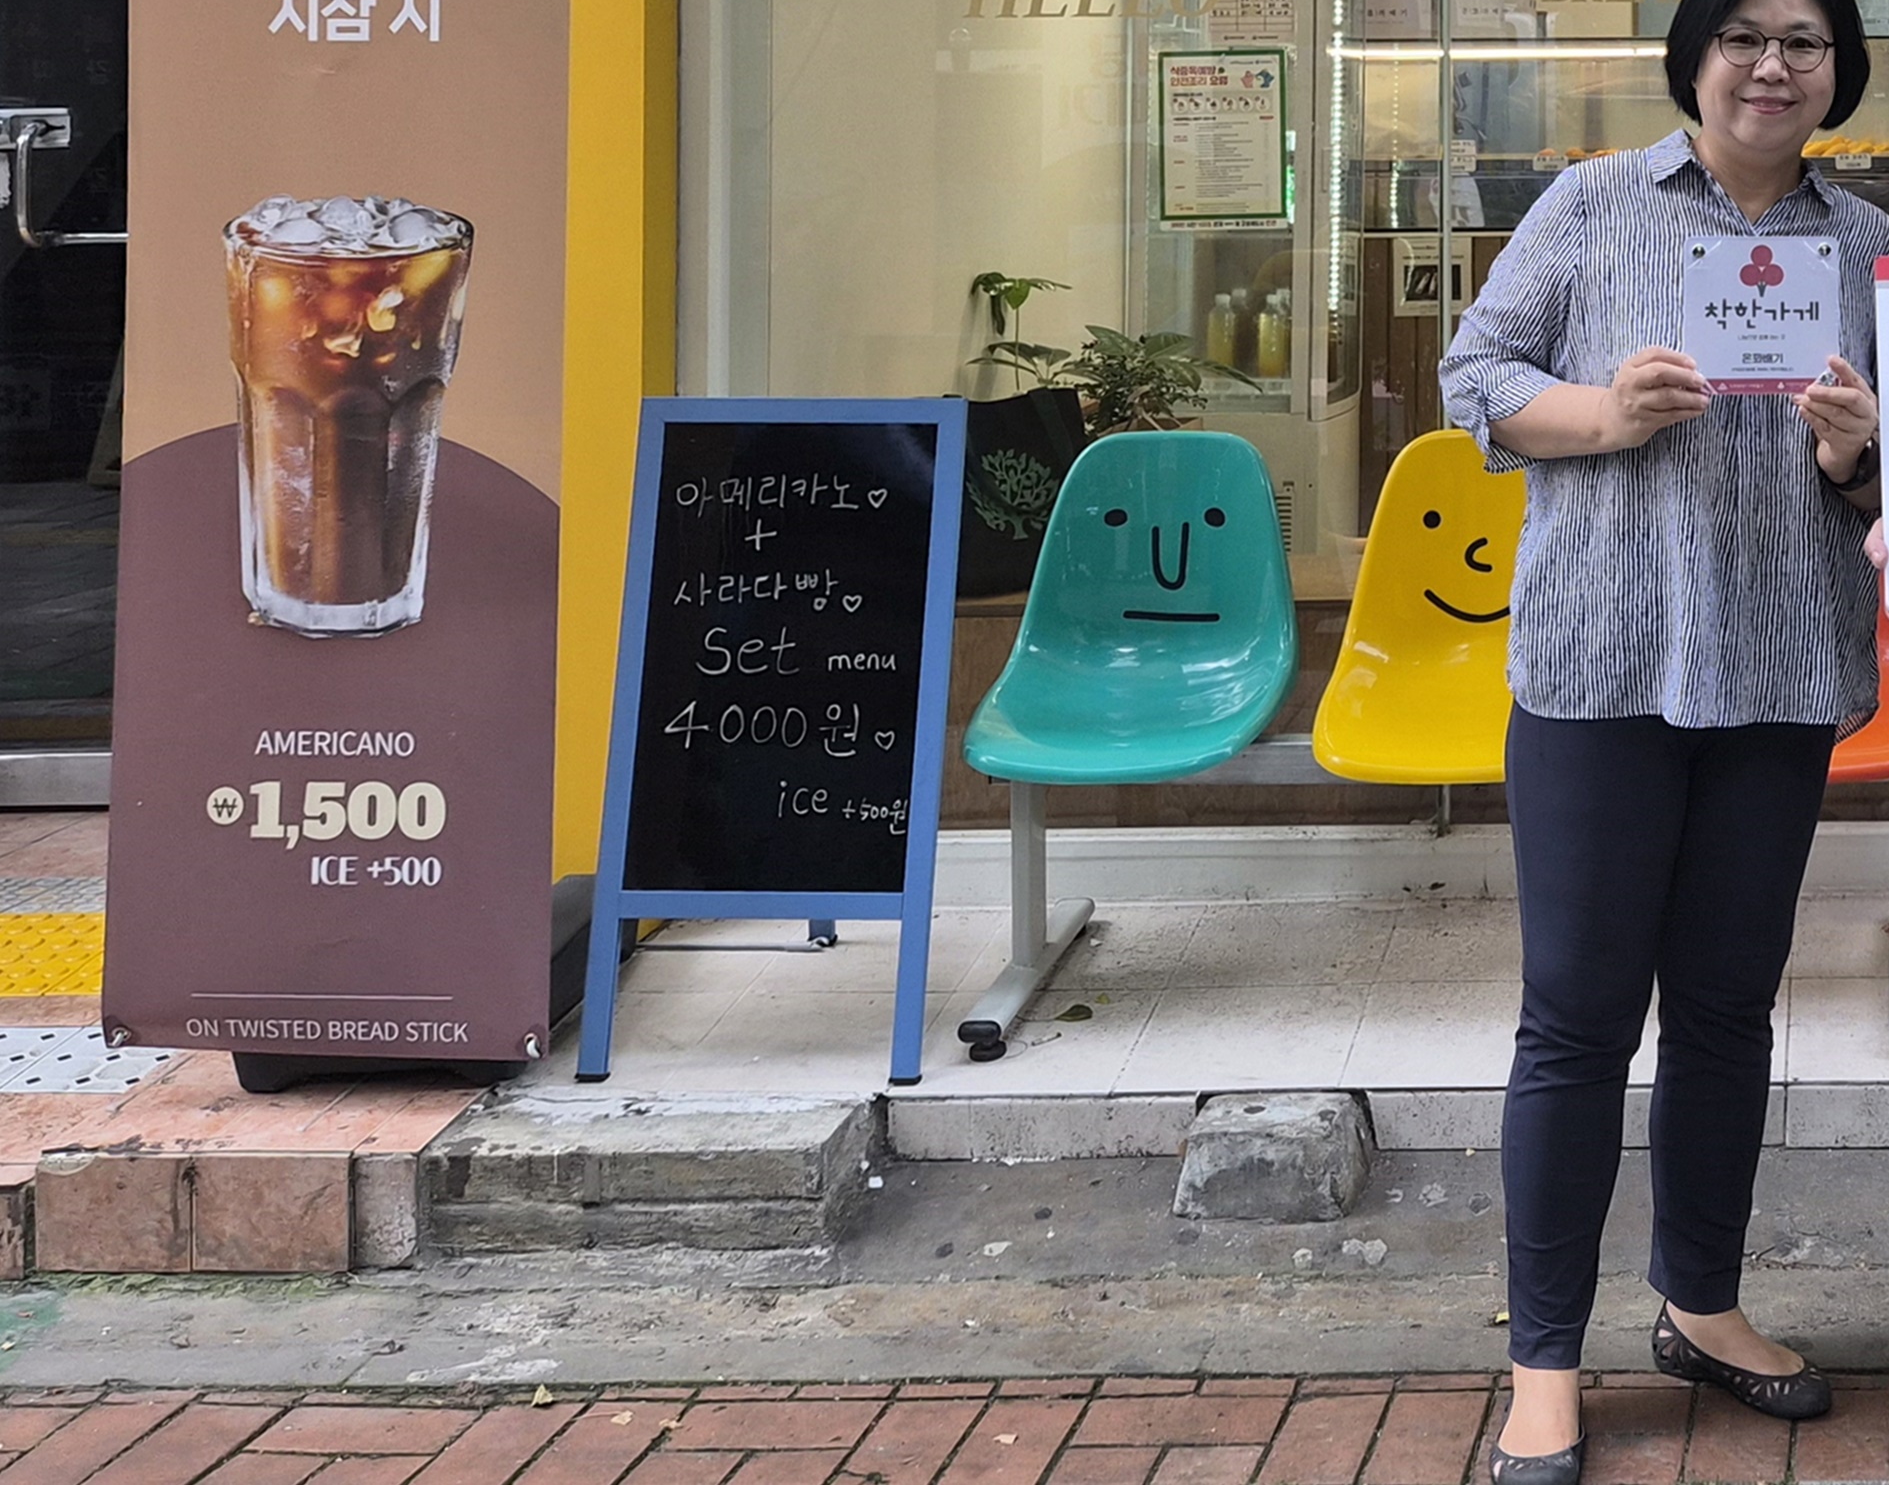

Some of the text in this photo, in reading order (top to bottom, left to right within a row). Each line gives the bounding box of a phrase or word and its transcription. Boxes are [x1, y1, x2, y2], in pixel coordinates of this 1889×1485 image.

[1704, 298, 1820, 330] 착한가게
[675, 472, 861, 518] 아메리카노
[673, 568, 839, 612] 사라다빵
[695, 625, 897, 676] Set menu
[254, 730, 416, 757] AMERICANO
[777, 780, 829, 818] ice
[310, 856, 443, 887] ICE +500
[186, 1018, 469, 1043] ON TWISTED BREAD STICK
